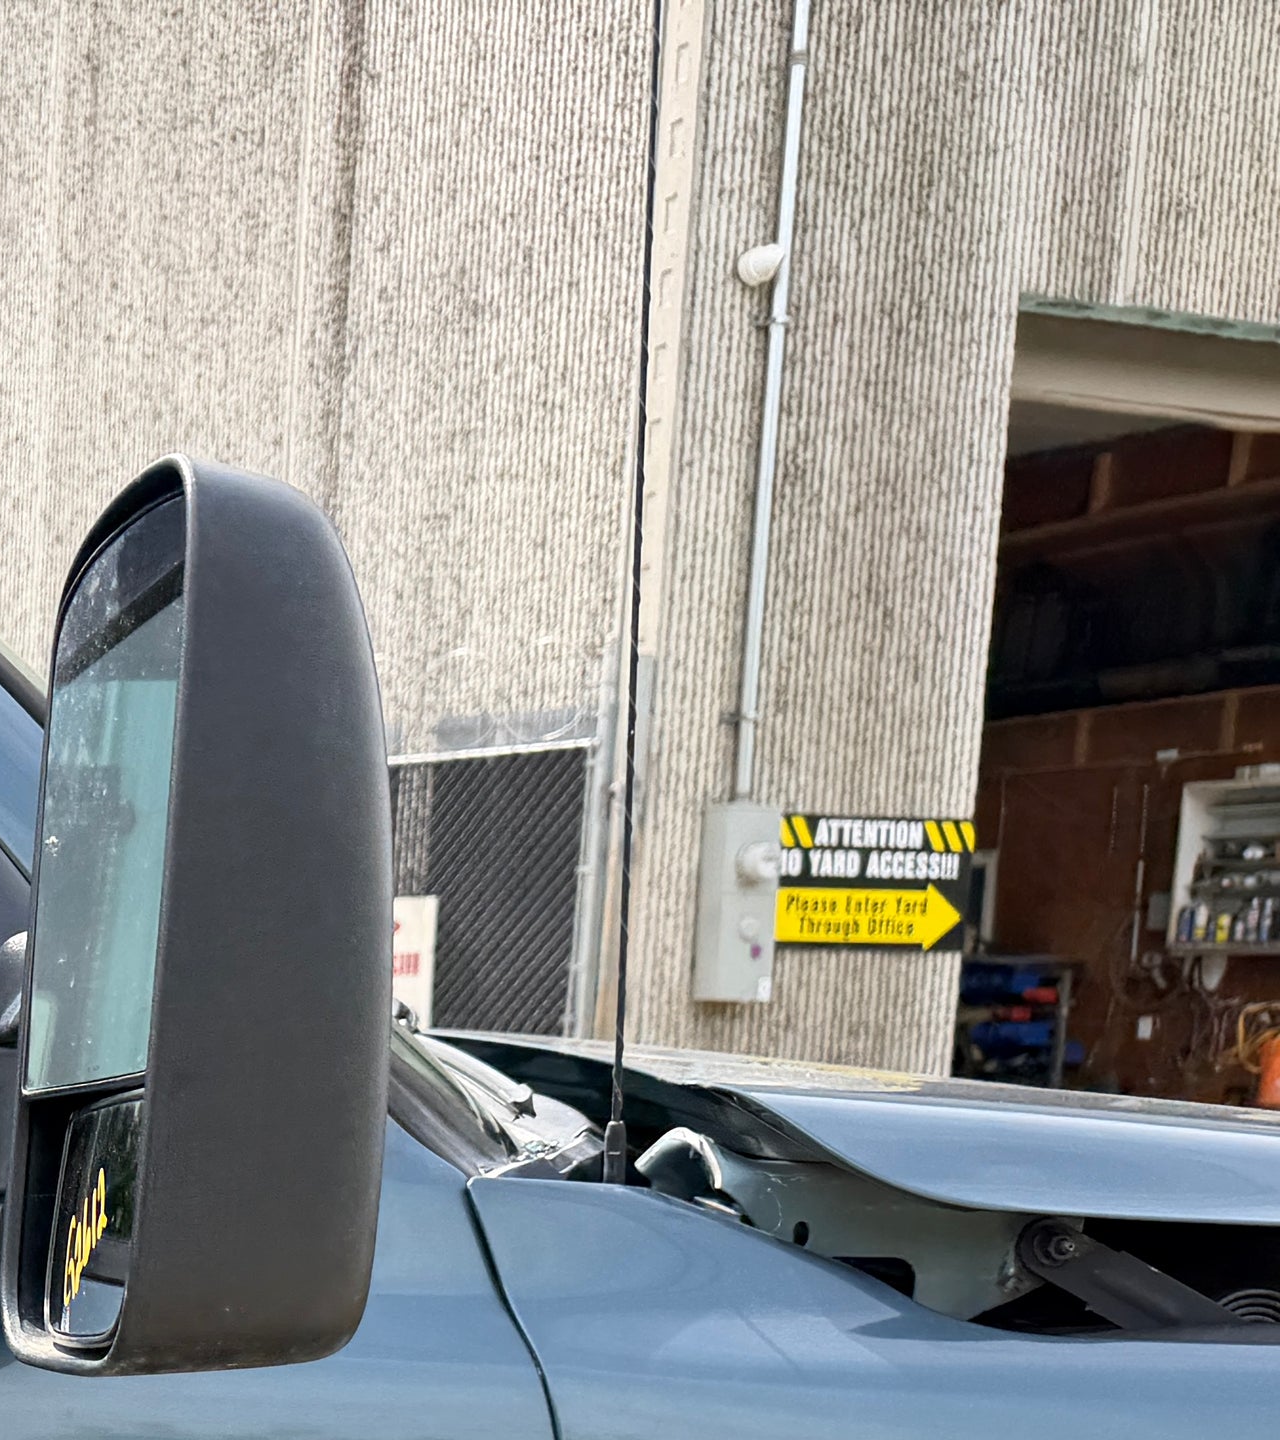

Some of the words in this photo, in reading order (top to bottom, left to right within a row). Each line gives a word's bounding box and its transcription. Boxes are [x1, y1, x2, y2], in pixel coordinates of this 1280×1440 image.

[814, 818, 924, 850] ATTENTION
[808, 850, 861, 877] YARD
[786, 894, 837, 914] Please
[845, 896, 885, 914] Enter
[896, 897, 928, 915] Yard
[799, 917, 860, 939] Through
[867, 918, 914, 936] Office
